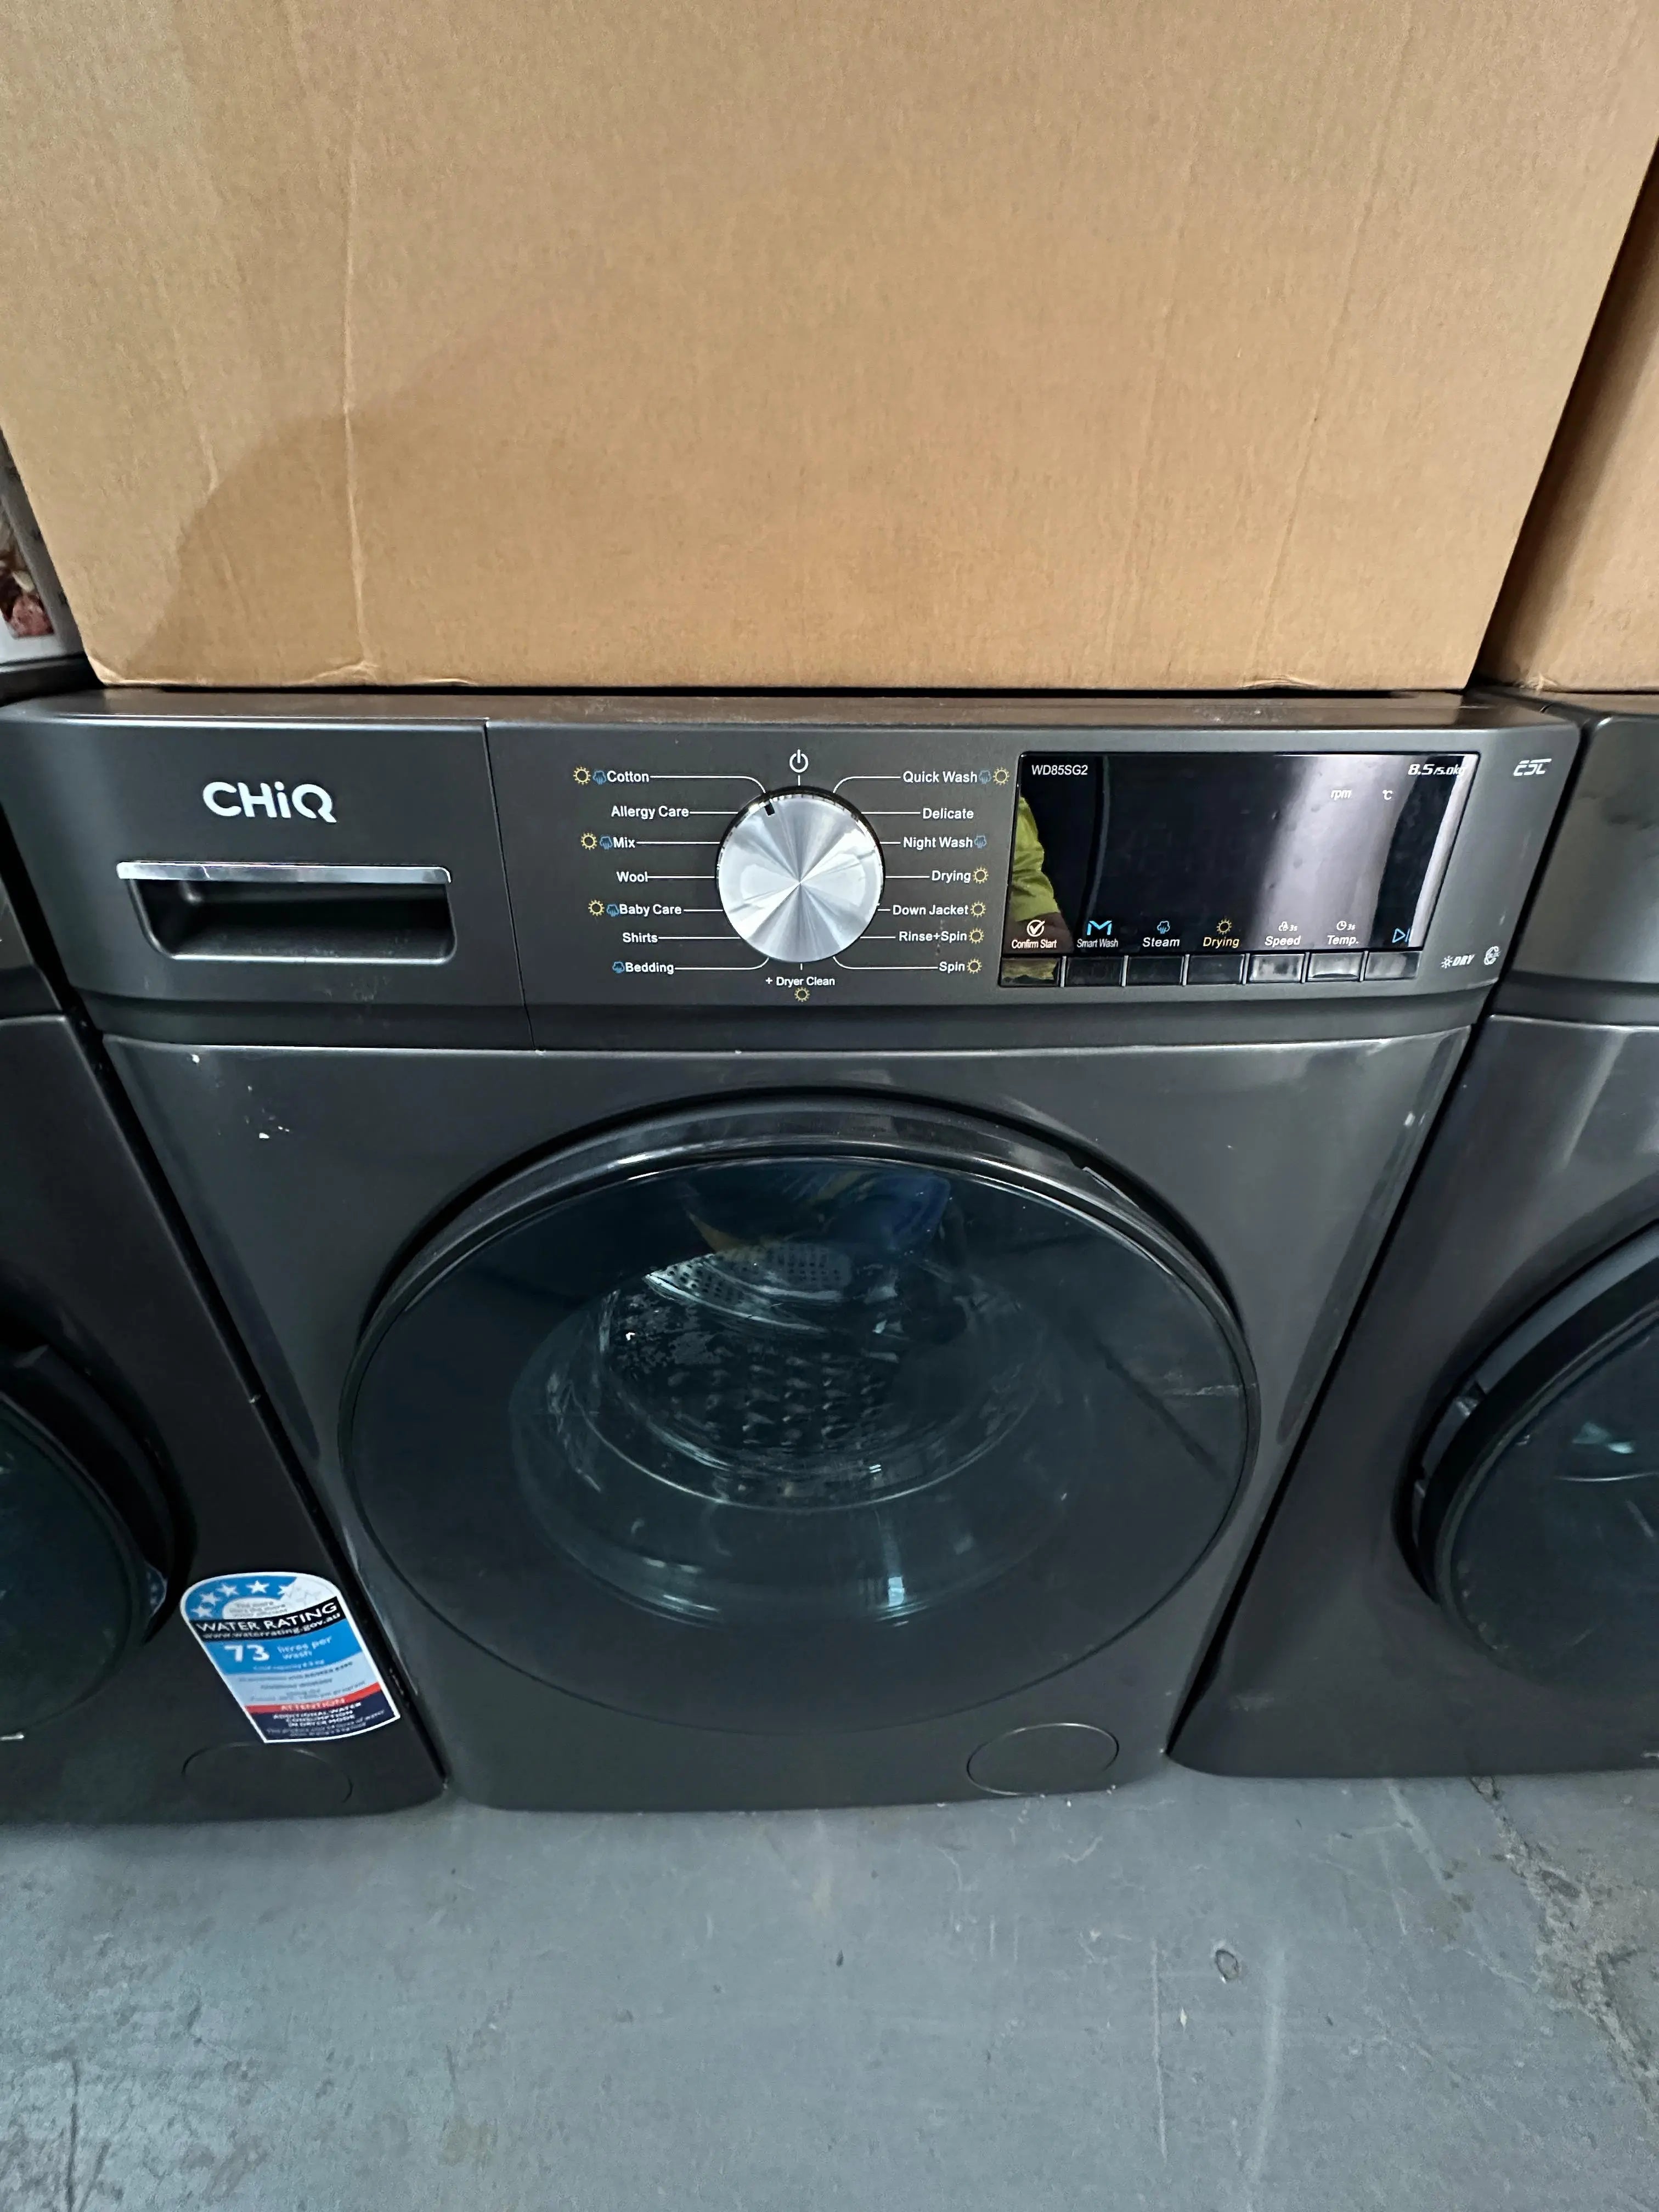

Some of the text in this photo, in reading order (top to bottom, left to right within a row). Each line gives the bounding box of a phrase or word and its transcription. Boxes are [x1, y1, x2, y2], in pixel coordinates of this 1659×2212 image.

[606, 770, 650, 782] Cotton
[902, 770, 978, 783] Quick Wash
[1031, 764, 1088, 776] WD85SG2
[1330, 789, 1352, 800] rpm
[202, 781, 337, 823] CHiQ
[611, 805, 690, 820] Allergy Care
[923, 808, 974, 819] Delicate
[612, 837, 636, 848] Mix
[903, 836, 973, 850] Night Wash
[616, 870, 649, 884] Wool
[932, 870, 972, 883] Drying
[618, 904, 682, 917] Baby Care
[893, 904, 969, 915] Down Jacket
[622, 932, 658, 943] Shirts
[899, 930, 967, 944] Rinse+Spin
[1076, 938, 1119, 948] Smart Wash
[1142, 936, 1180, 947] Steam
[1203, 936, 1240, 949] Drying
[1265, 934, 1302, 947] Speed
[1327, 934, 1360, 946] Temp.
[1011, 939, 1057, 949] Confirm Start
[1452, 954, 1476, 967] DRY
[625, 962, 674, 975] Bedding
[939, 961, 966, 974] Spin
[776, 976, 804, 988] Dryer
[806, 976, 836, 986] Clean
[196, 1620, 261, 1632] WATER
[263, 1602, 337, 1629] RATING
[224, 1645, 270, 1663] 73
